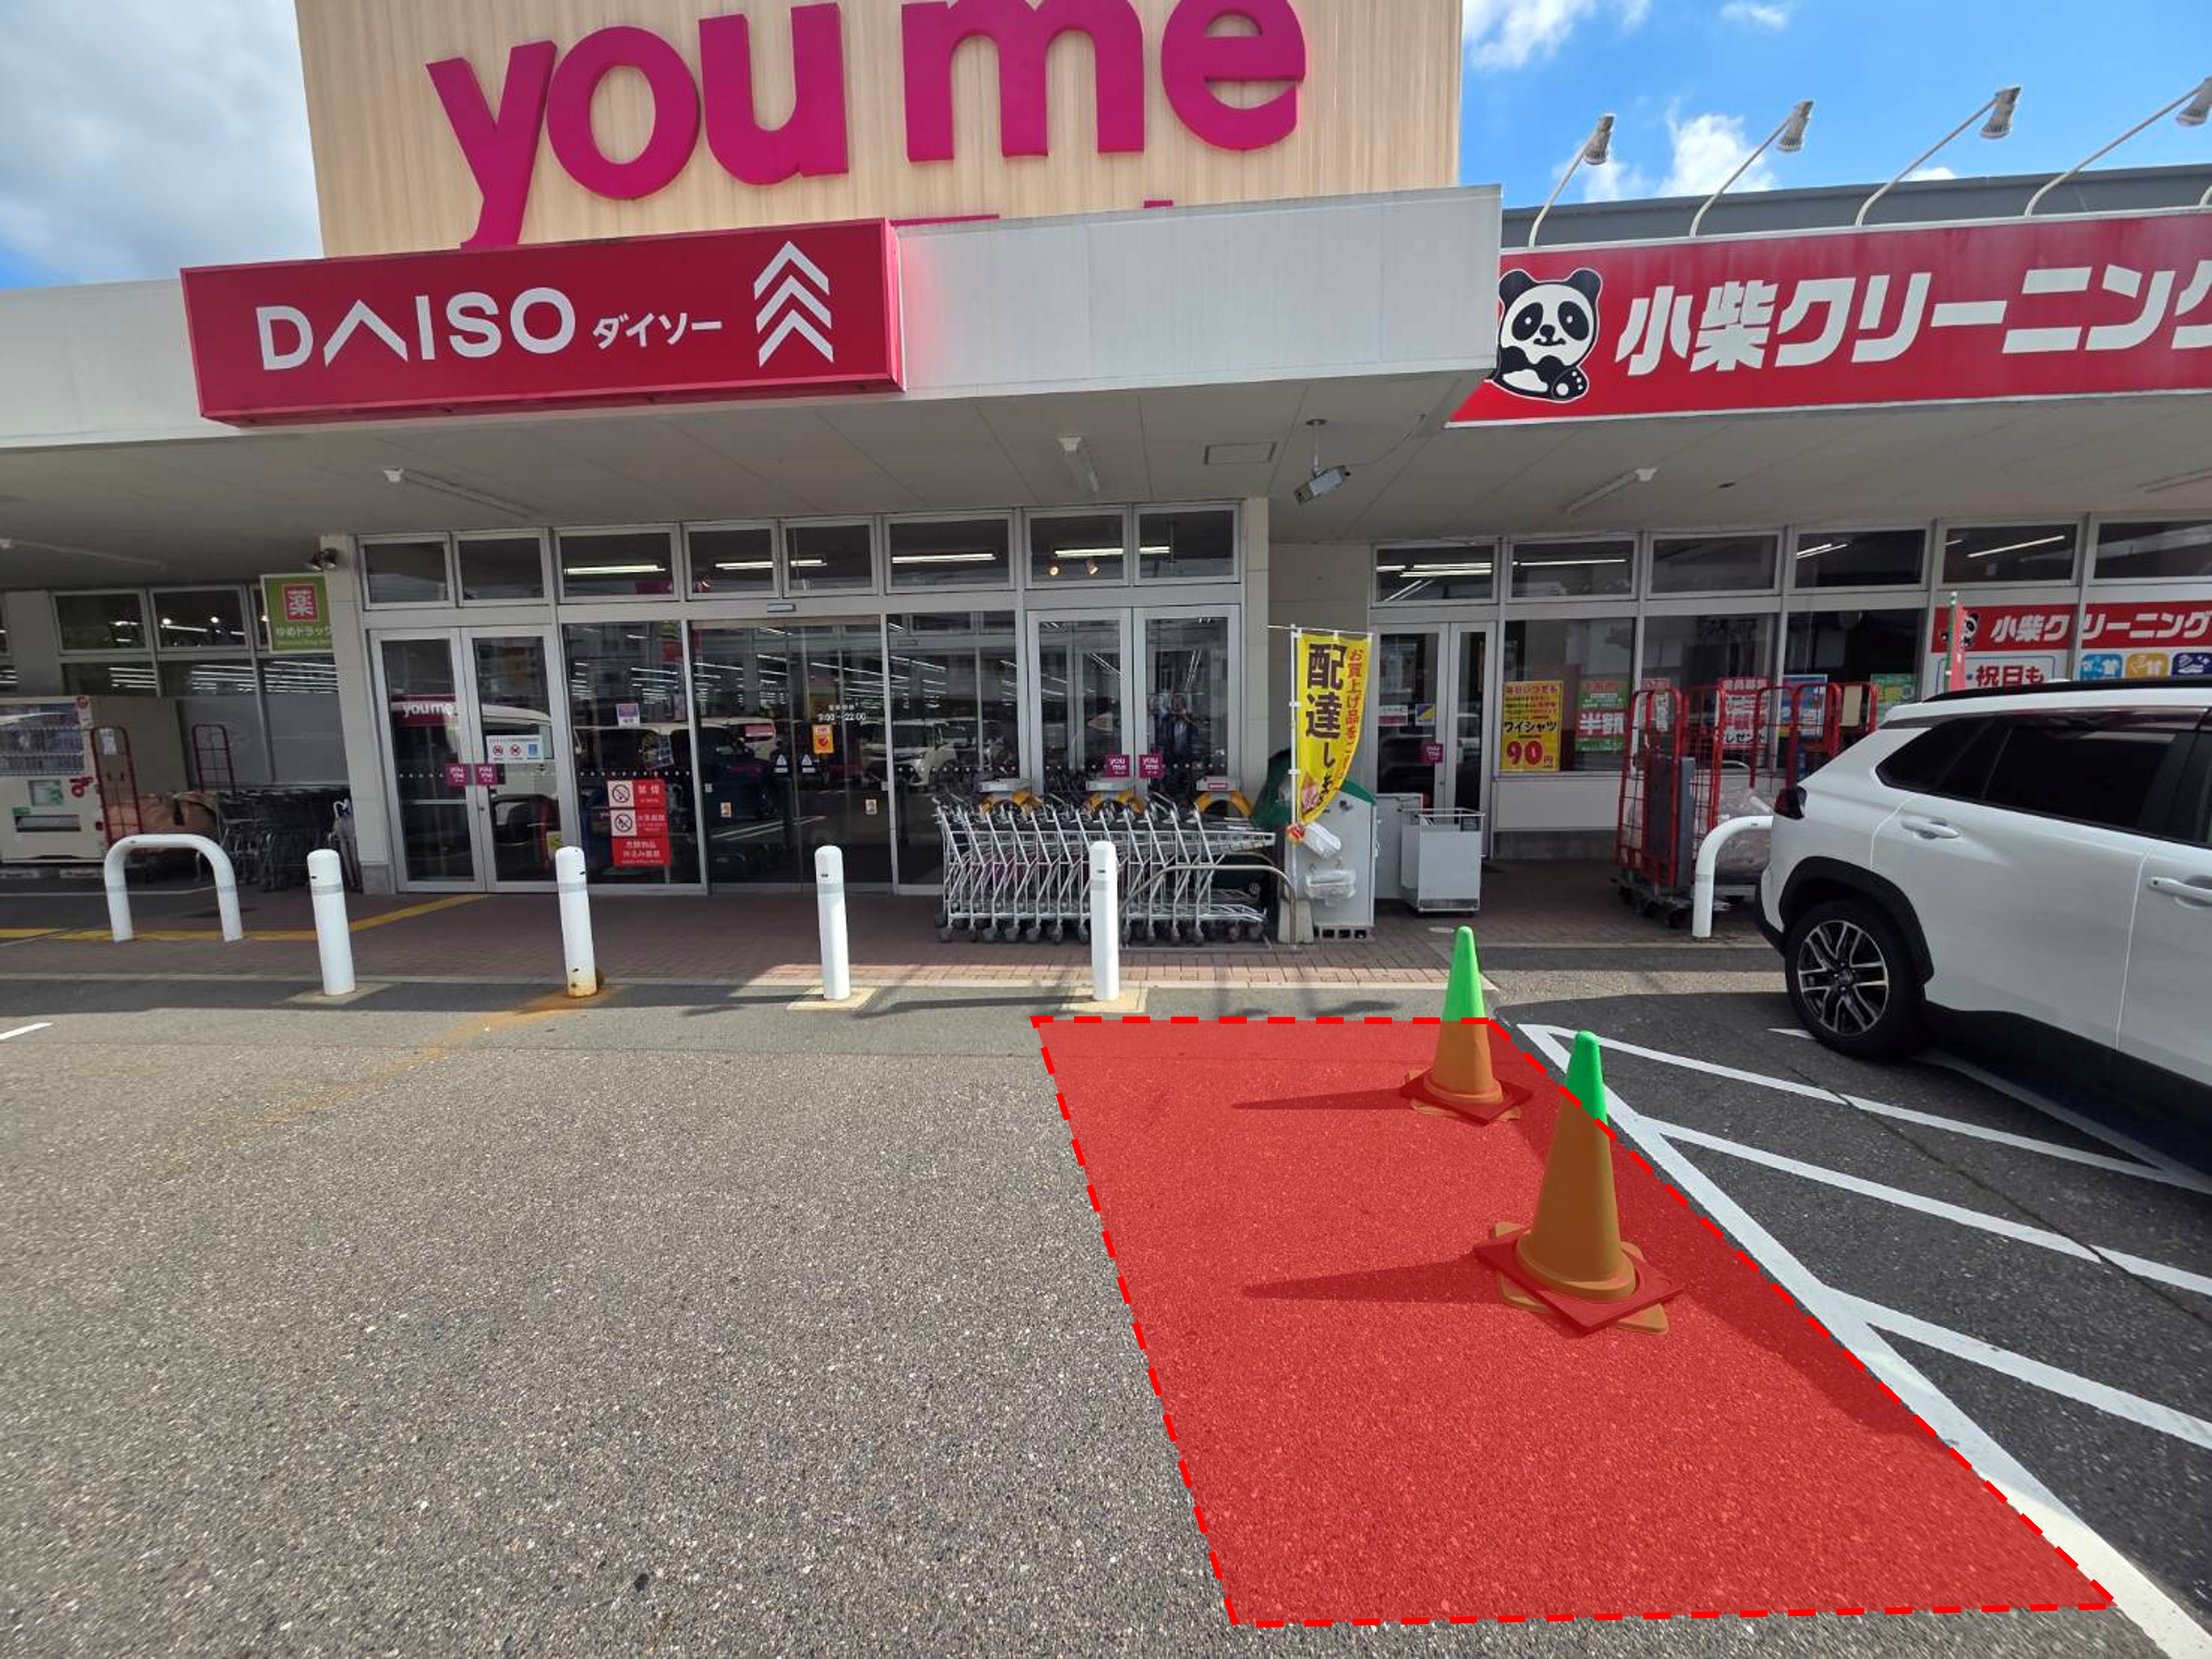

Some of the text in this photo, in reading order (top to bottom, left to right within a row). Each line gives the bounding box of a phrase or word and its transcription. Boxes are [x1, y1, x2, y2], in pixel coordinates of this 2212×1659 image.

[426, 0, 1305, 249] you me
[255, 287, 722, 371] DAISO ダイソー
[1305, 643, 1347, 803] 配達しま
[1504, 721, 1557, 733] ワイシャツ
[1579, 713, 1625, 735] 半額
